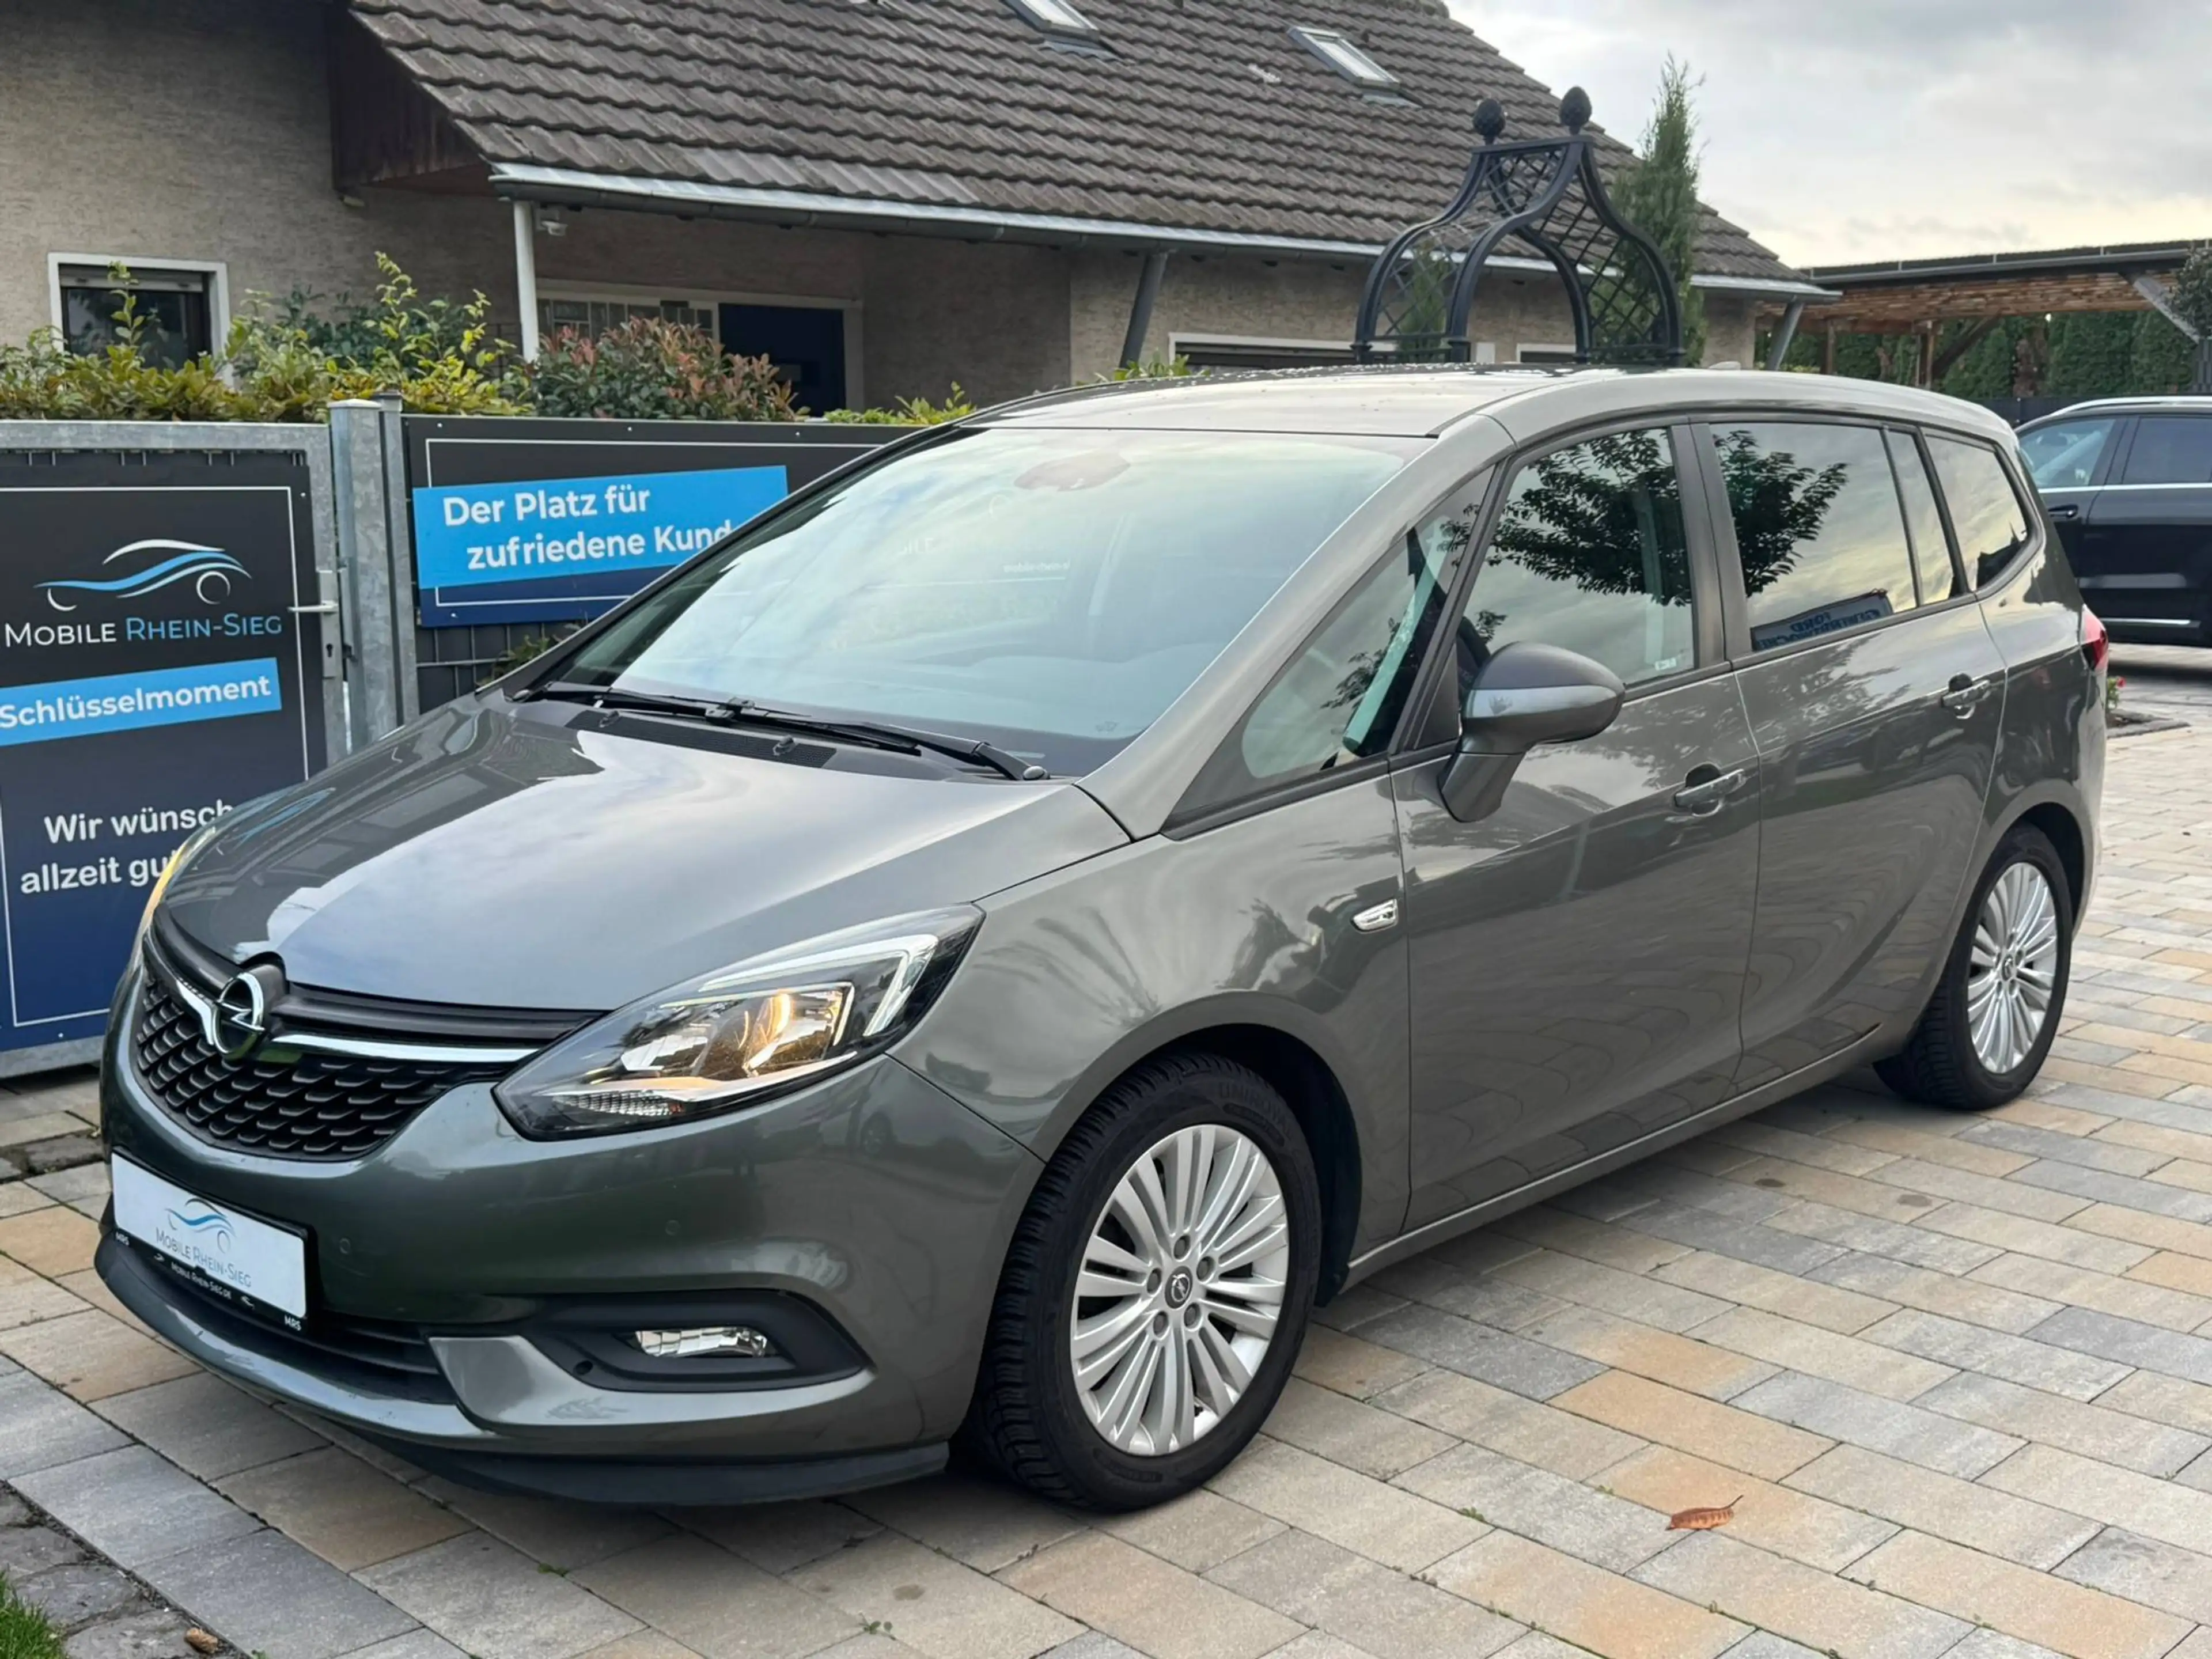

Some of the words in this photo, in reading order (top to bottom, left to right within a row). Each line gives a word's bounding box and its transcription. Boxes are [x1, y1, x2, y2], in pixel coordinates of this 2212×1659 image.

[442, 497, 505, 527] Der
[514, 489, 598, 521] Platz
[604, 484, 651, 514] für
[467, 529, 646, 570] zufriedene
[5, 622, 117, 648] MOBILE
[125, 612, 282, 641] RHEIN-SIEG
[0, 675, 271, 728] Schlüsselmoment
[44, 813, 104, 843] Wir
[20, 855, 122, 895] allzeit
[128, 850, 176, 887] gu
[156, 1227, 191, 1260] MOBILE
[192, 1245, 252, 1288] RHEIN-SIEG
